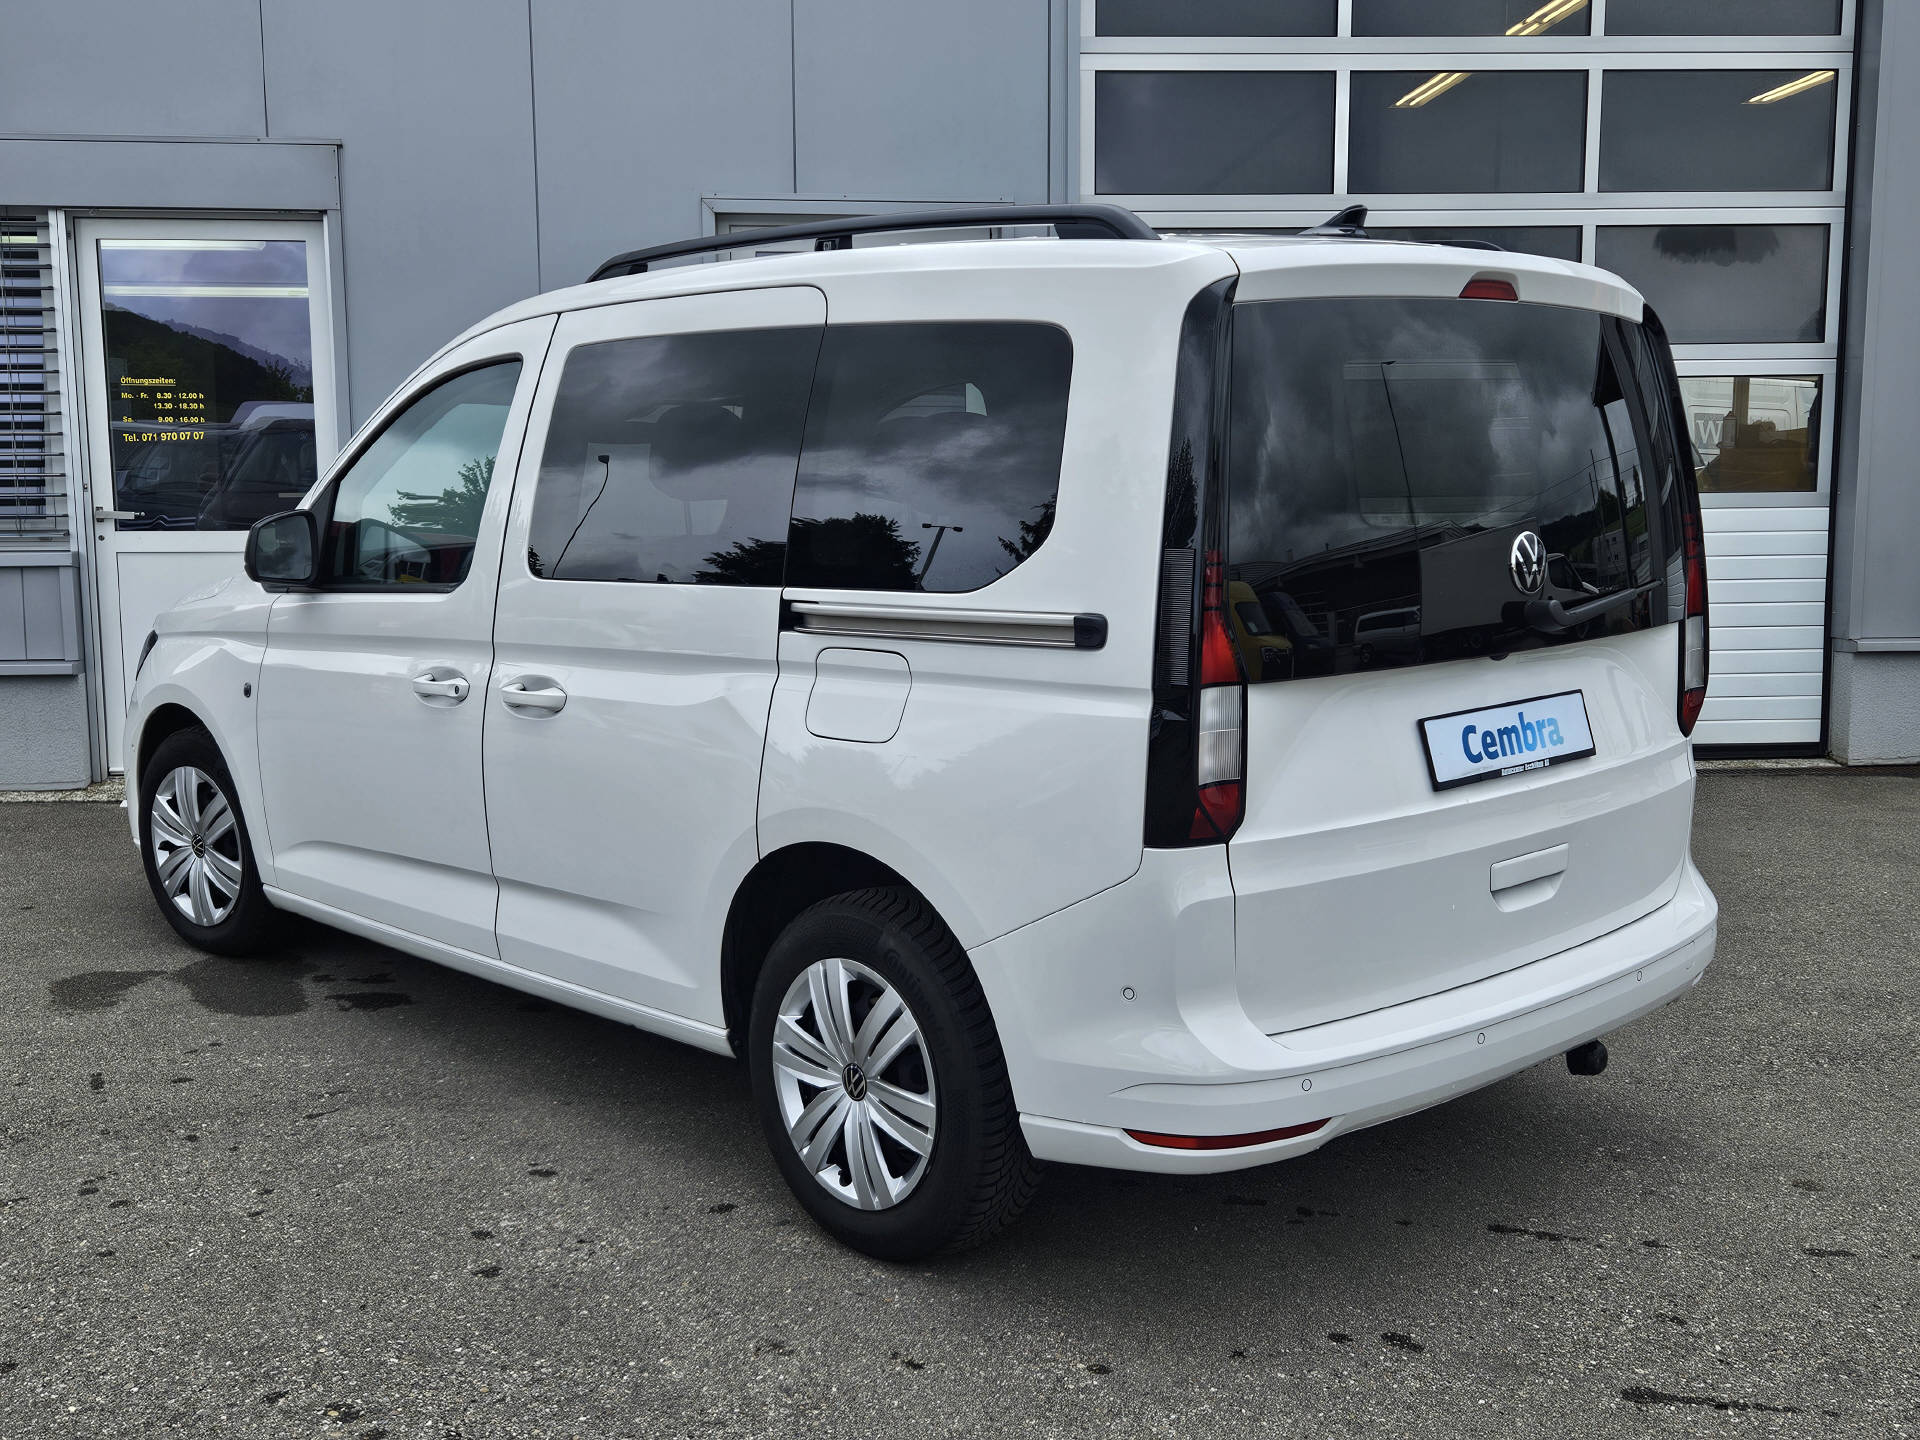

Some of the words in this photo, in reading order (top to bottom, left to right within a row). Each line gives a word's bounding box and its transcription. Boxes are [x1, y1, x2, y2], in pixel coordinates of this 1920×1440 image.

[120, 376, 176, 386] Öffnungszeiten:
[122, 434, 139, 442] Tel.
[141, 433, 158, 441] 071
[160, 432, 178, 441] 970
[179, 432, 191, 440] 07
[193, 431, 205, 440] 07
[1461, 711, 1564, 764] Cembra
